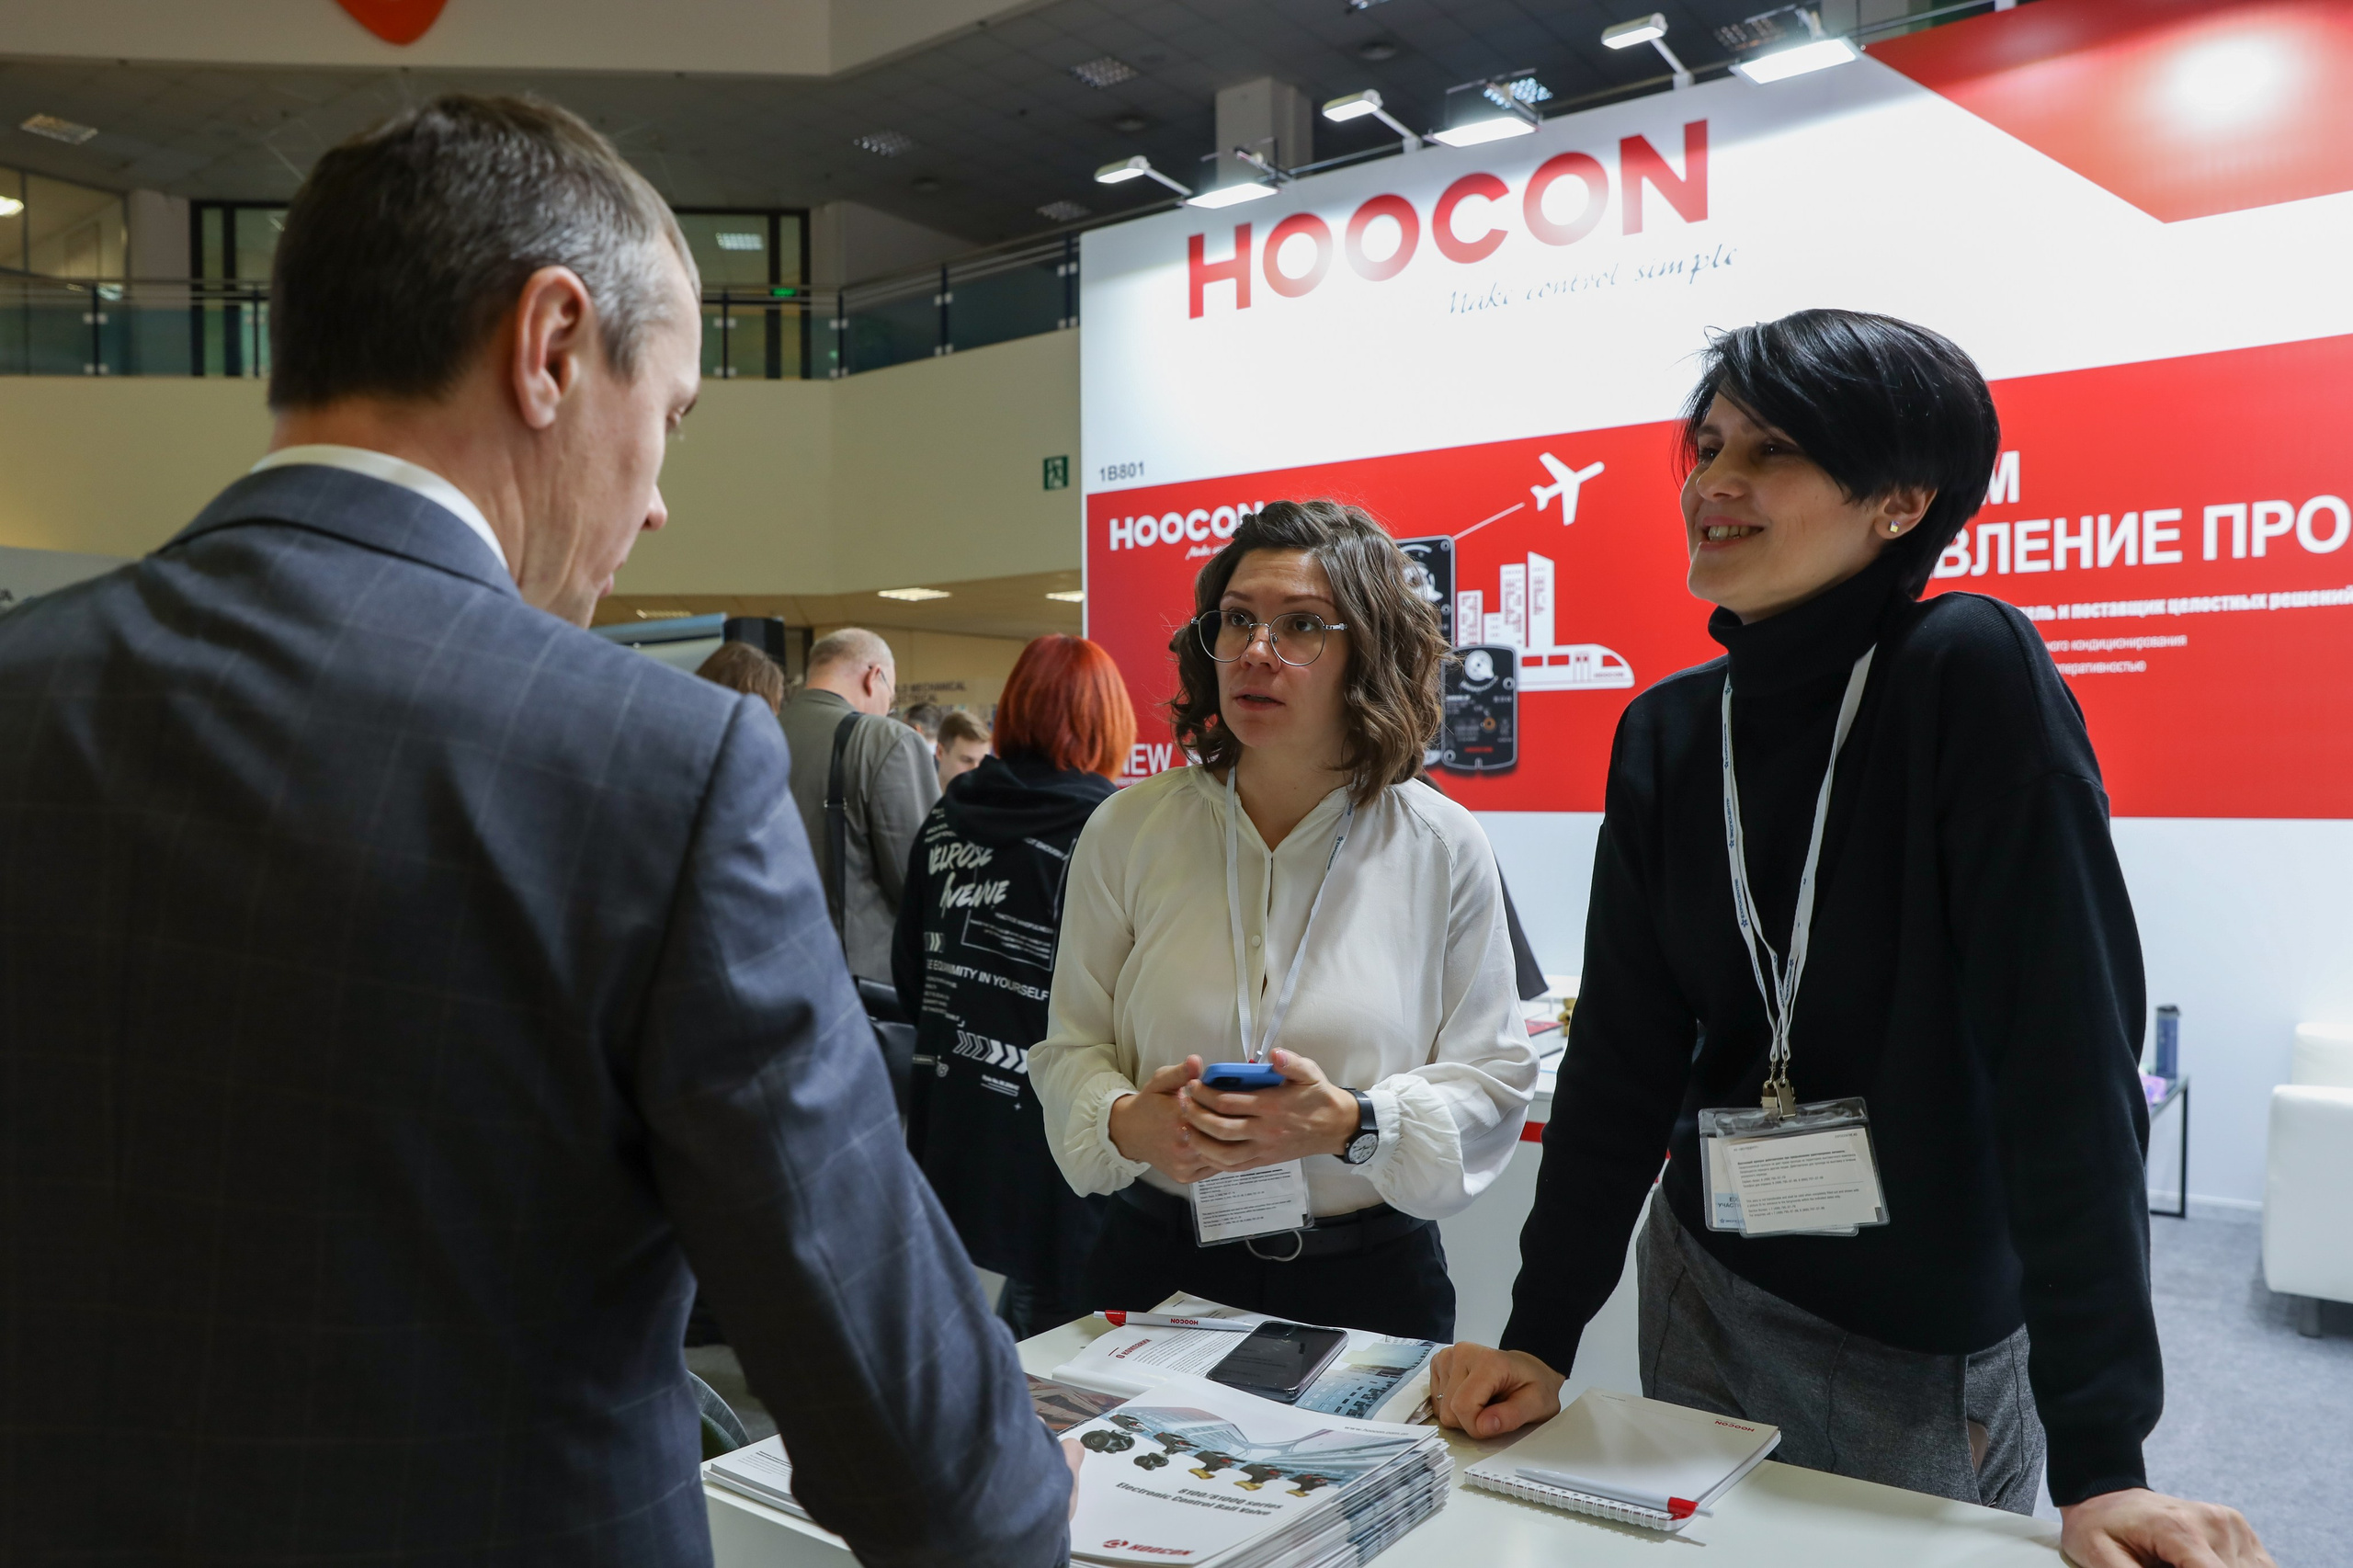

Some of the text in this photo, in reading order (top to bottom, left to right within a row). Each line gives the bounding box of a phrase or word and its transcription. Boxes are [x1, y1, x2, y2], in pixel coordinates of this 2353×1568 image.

[1188, 119, 1708, 320] HOOCON
[1098, 460, 1145, 483] 1B801
[1930, 494, 2352, 579] ВЛЕНИЕ ПРО
[2166, 593, 2268, 616] целостных
[978, 971, 992, 984] IN
[993, 974, 1050, 1001] YOURSELF
[1170, 1318, 1199, 1326] HOOCON
[1714, 1419, 1755, 1433] HOOCON
[1115, 1482, 1272, 1517] Electronic Control Ball Valve
[1245, 1499, 1284, 1510] series
[1127, 1543, 1195, 1557] HOOCON
